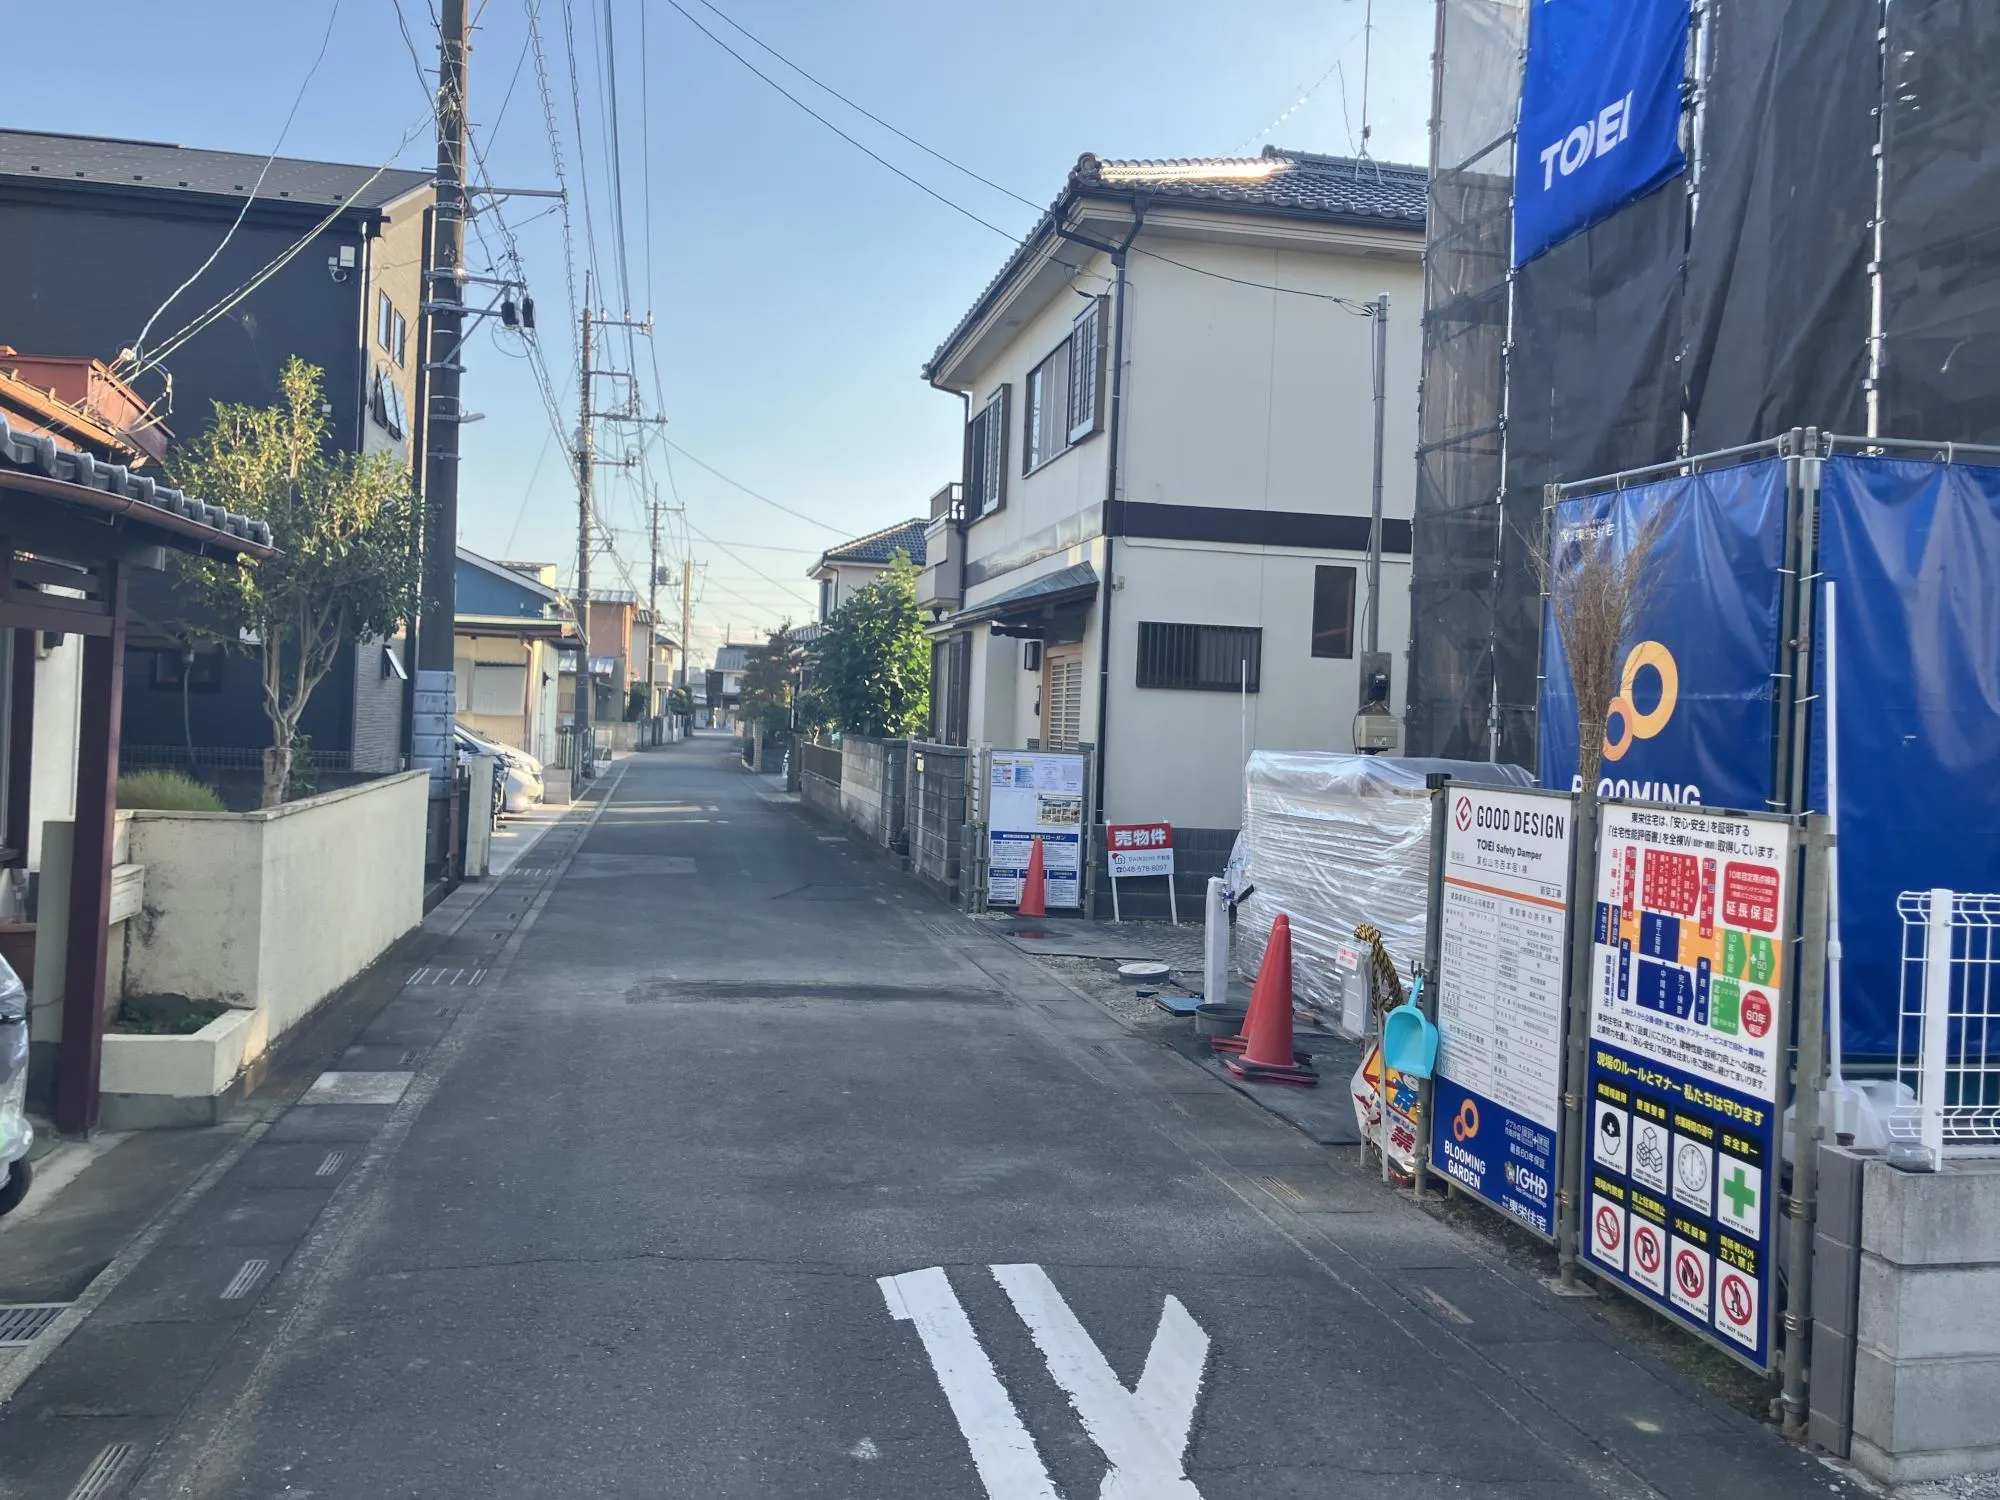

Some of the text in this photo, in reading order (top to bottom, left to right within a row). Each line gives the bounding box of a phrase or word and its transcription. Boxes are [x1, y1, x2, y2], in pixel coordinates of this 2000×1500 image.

[1476, 806, 1563, 838] GOOD DESIGN
[1114, 828, 1166, 847] 売物件
[1496, 844, 1515, 856] Safety
[1517, 848, 1542, 860] Damper
[1726, 901, 1774, 923] 延長保証
[1746, 1010, 1766, 1025] 60年
[1596, 1051, 1763, 1128] 現場のルールとマナー 私たちは守ります
[1444, 1140, 1485, 1174] BLOOMING
[1723, 1135, 1758, 1158] 安全第一
[1447, 1159, 1480, 1189] GARDEN
[1509, 1198, 1546, 1231] 東栄住宅
[1722, 1216, 1754, 1235] SAFETY FIRST
[1720, 1235, 1753, 1259] 関係者以外
[1720, 1248, 1754, 1273] 立入禁止
